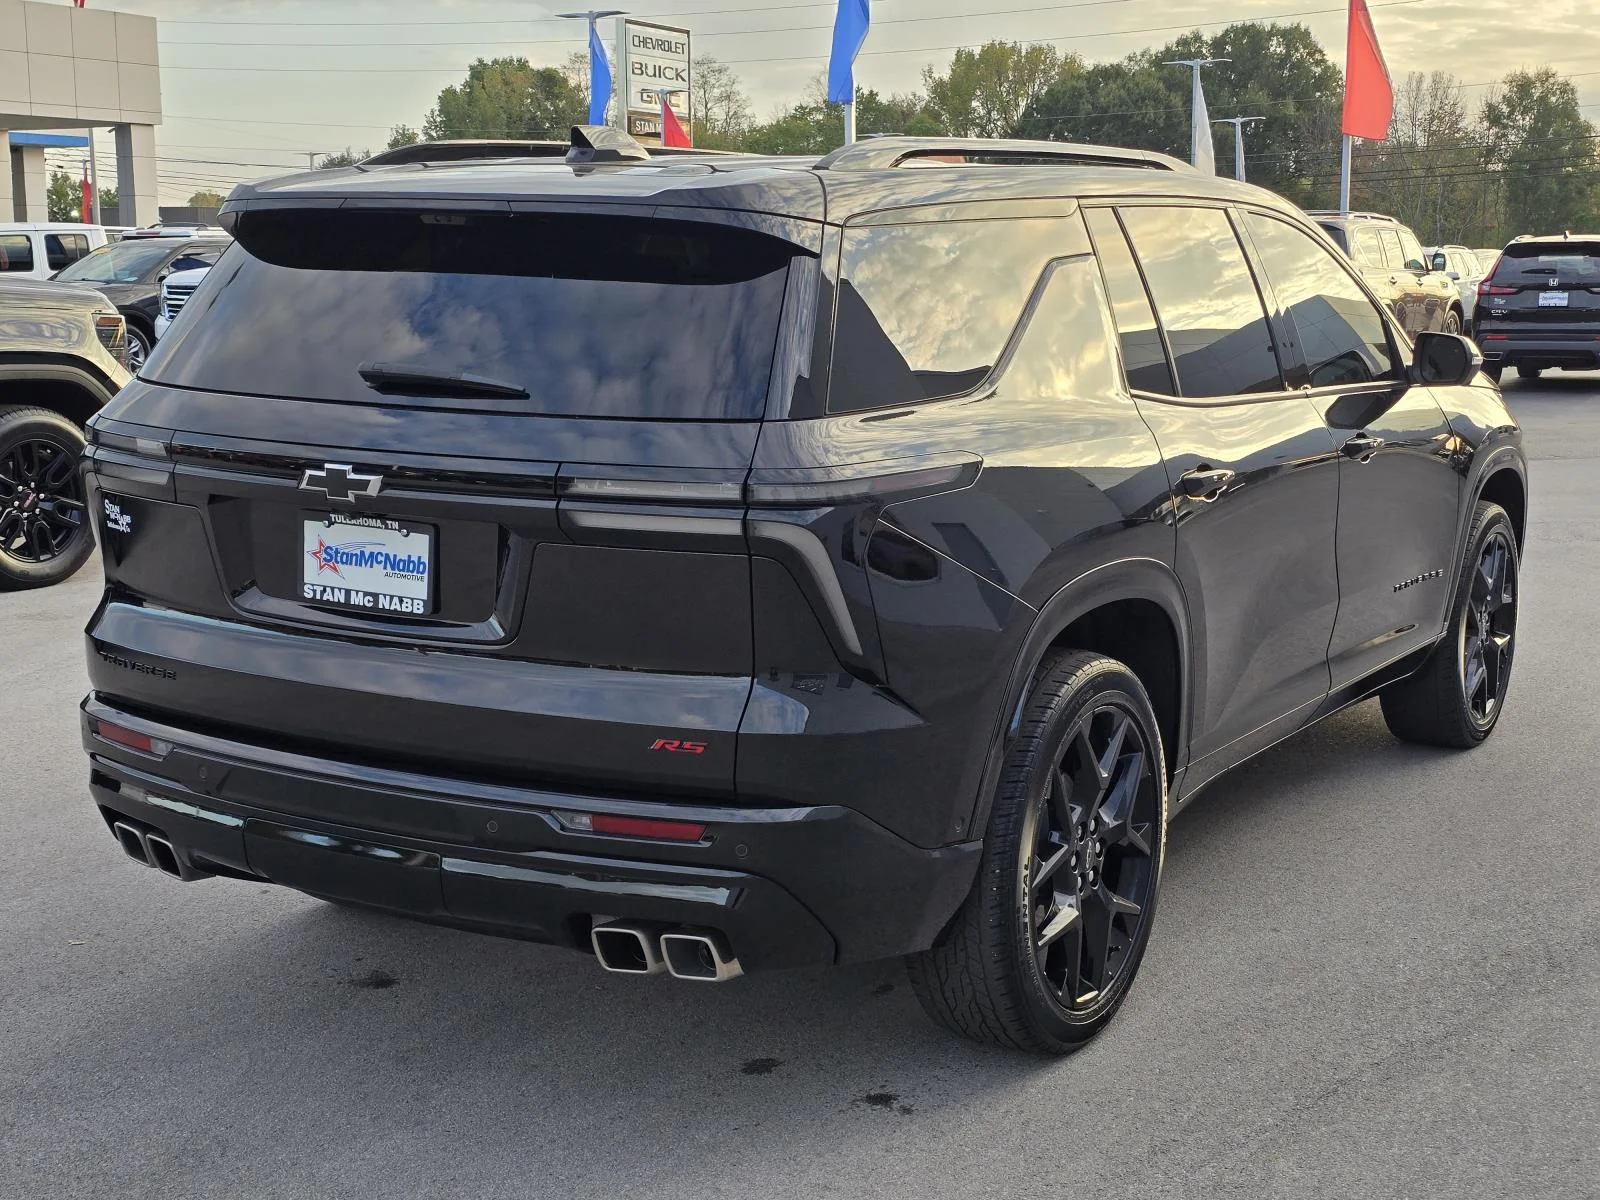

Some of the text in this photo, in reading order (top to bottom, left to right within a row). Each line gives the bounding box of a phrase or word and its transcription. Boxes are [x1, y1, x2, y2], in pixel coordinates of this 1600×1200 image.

[632, 34, 686, 55] CHEVROLET
[631, 60, 687, 82] BUICK
[635, 120, 655, 133] STAN
[386, 520, 399, 530] TN
[383, 571, 425, 583] AUTOMOTIVE
[303, 583, 346, 604] STAN
[378, 594, 425, 615] NABB
[649, 738, 708, 754] RS
